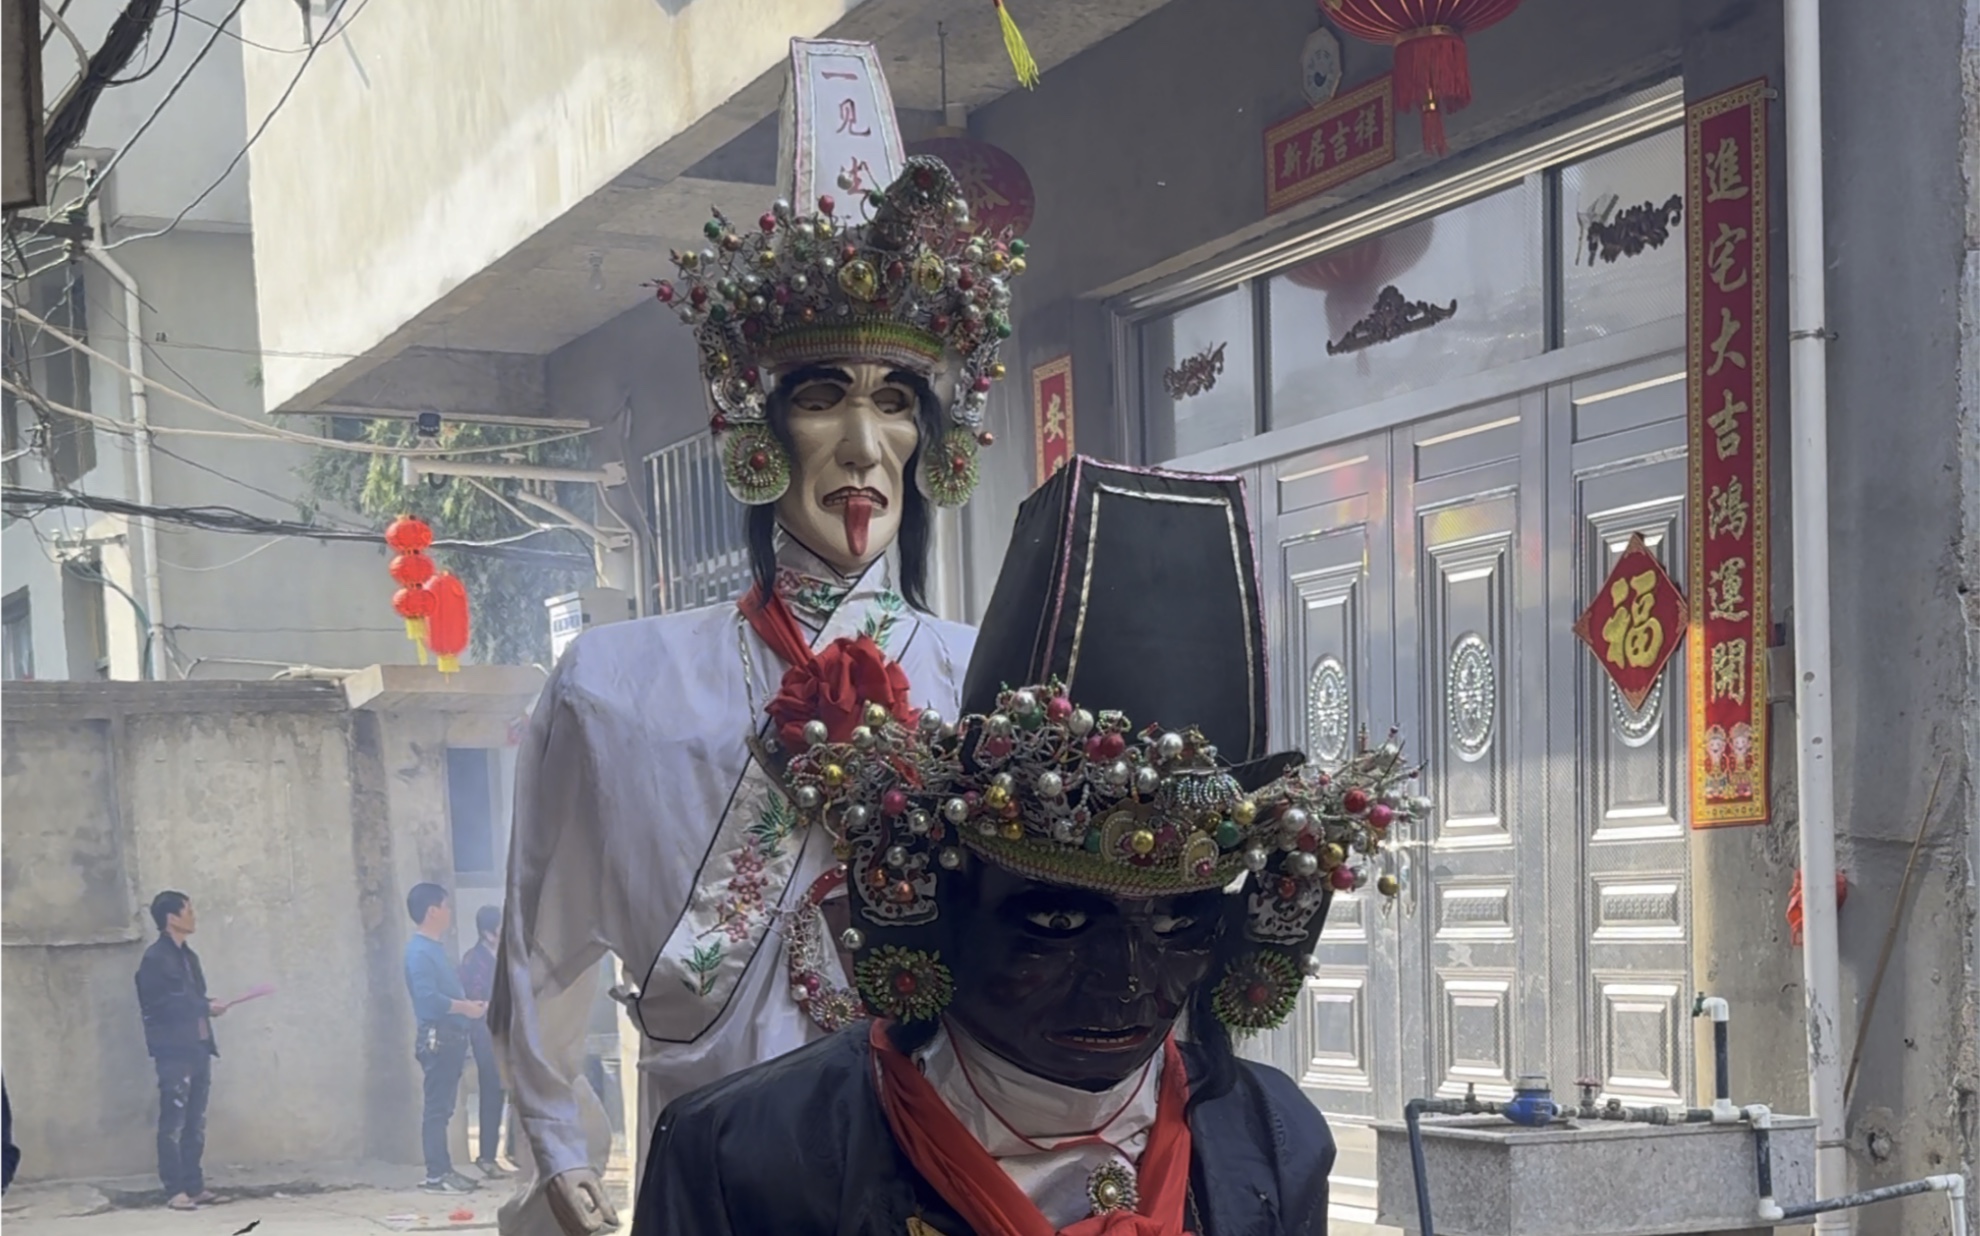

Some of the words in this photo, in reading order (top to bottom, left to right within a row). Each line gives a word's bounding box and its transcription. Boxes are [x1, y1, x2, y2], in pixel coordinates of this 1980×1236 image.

[1280, 103, 1379, 179] 新居吉祥
[1705, 137, 1750, 707] 進宅大吉鴻運開
[1602, 569, 1664, 670] 福
